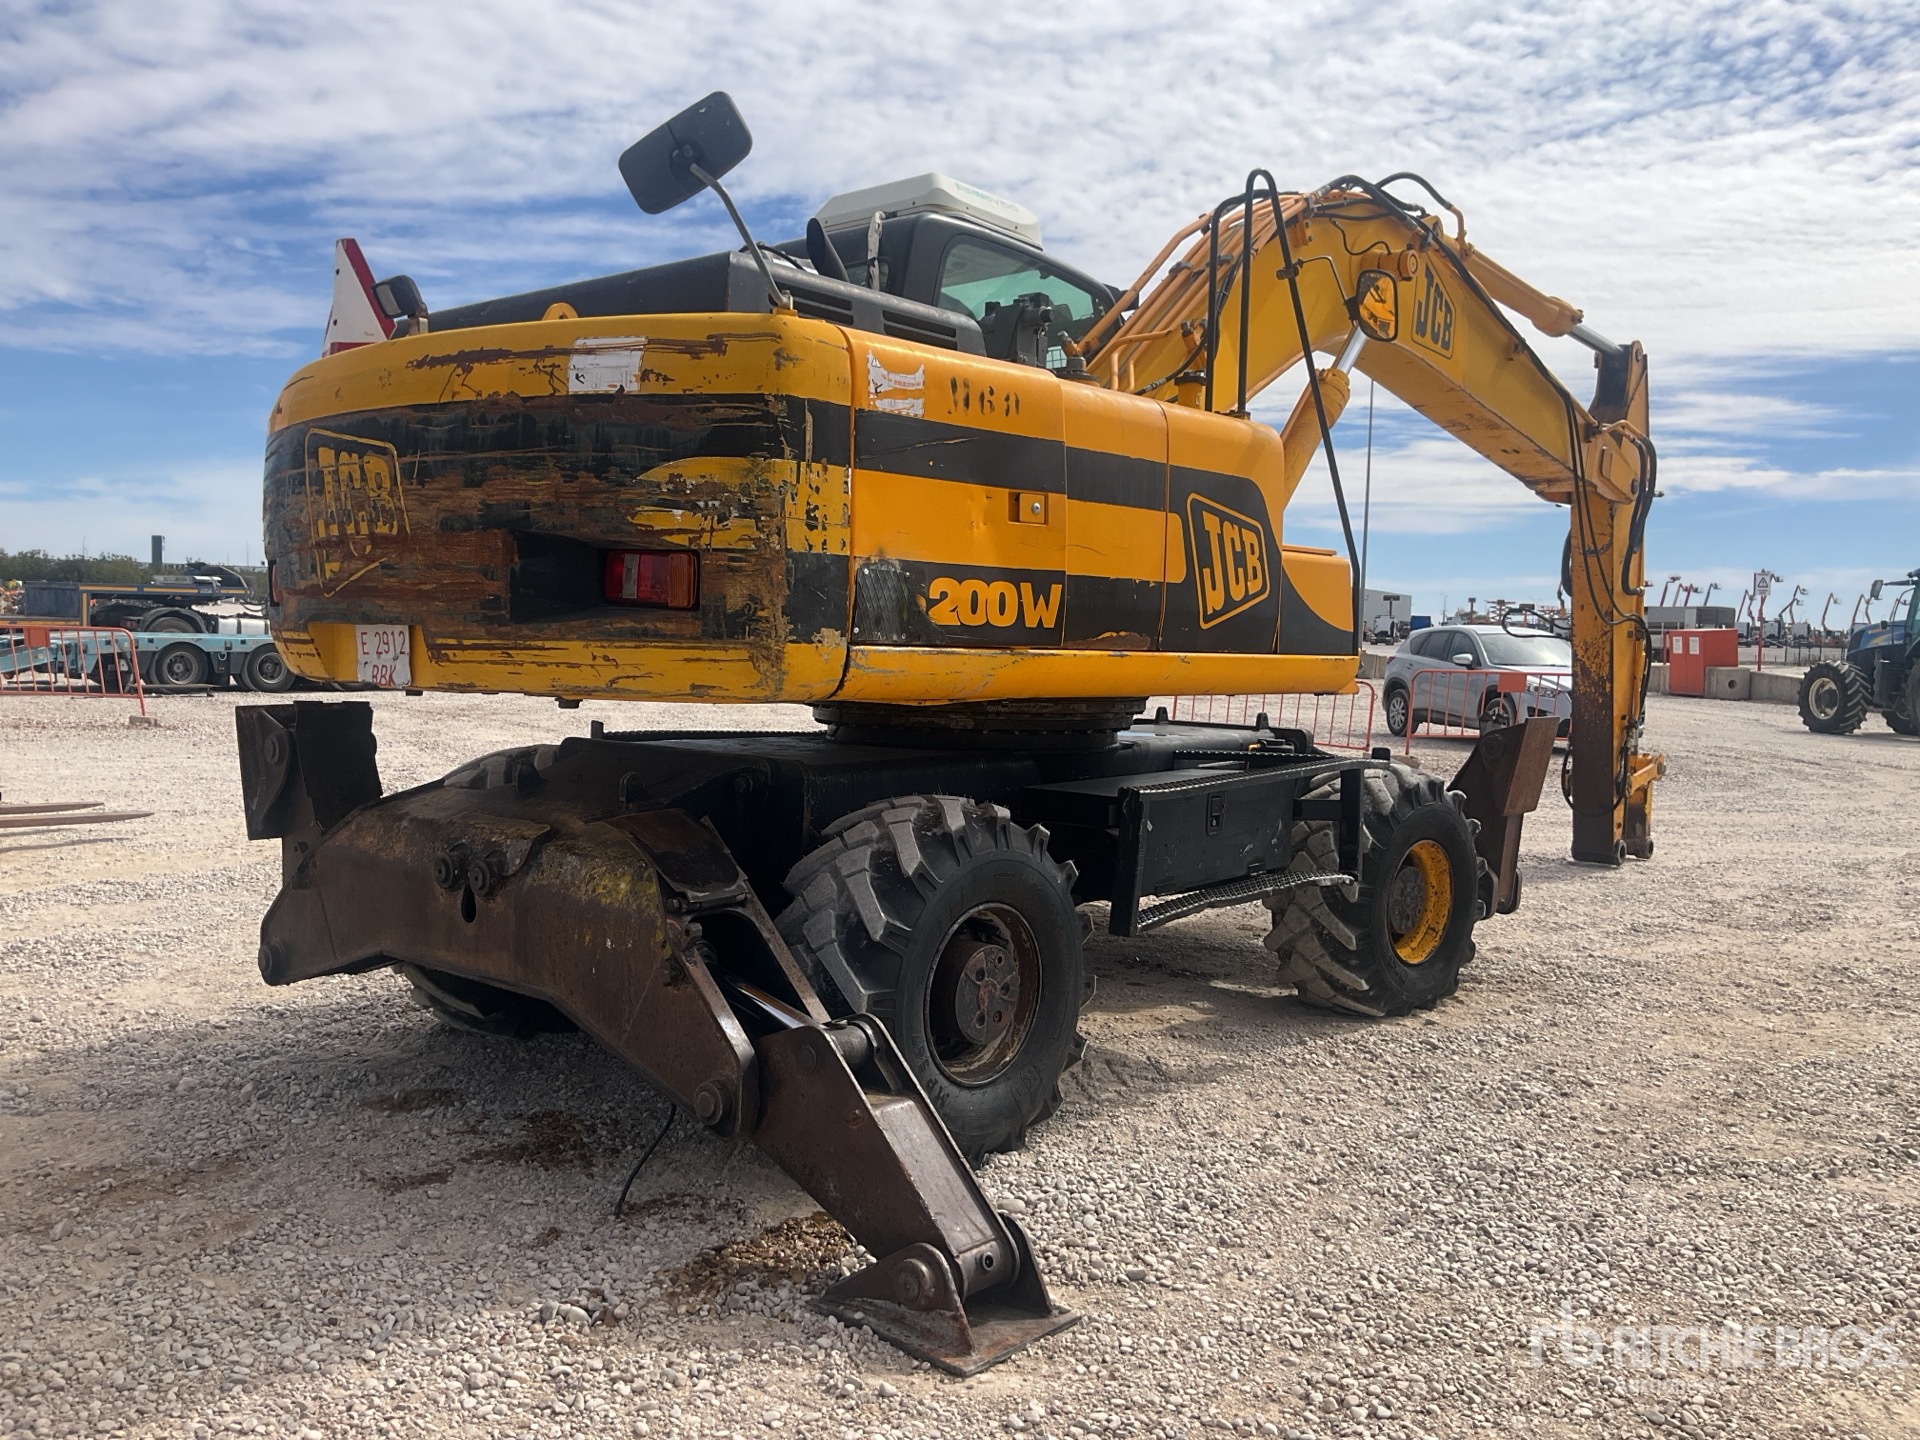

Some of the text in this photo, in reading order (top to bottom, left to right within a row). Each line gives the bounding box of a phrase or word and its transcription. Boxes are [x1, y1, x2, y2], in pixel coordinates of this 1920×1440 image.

[1415, 262, 1453, 351] JCB
[1202, 510, 1263, 615] JCB
[928, 577, 1062, 629] 200W
[360, 631, 370, 655] E
